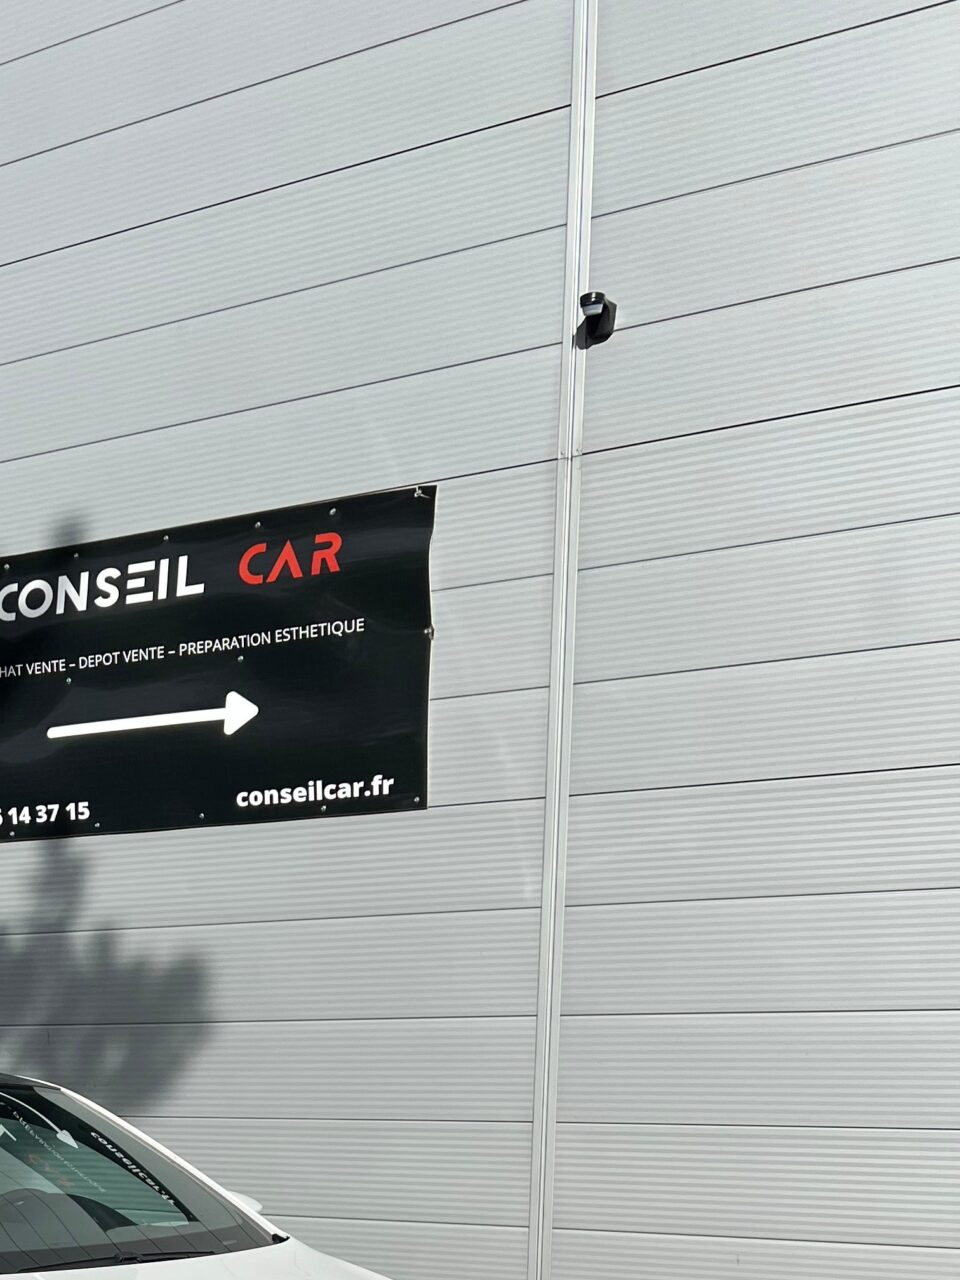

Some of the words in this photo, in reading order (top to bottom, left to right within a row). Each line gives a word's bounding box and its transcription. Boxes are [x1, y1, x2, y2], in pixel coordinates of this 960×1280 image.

[238, 531, 344, 586] CAR
[25, 660, 67, 675] VENTE
[78, 652, 121, 670] DEPOT
[122, 646, 165, 663] VENTE
[178, 631, 271, 656] PREPARATION
[274, 617, 366, 643] ESTHETIQUE
[7, 805, 32, 825] 14
[35, 803, 60, 824] 37
[65, 801, 91, 821] 15
[236, 774, 395, 808] conseilcar.fr
